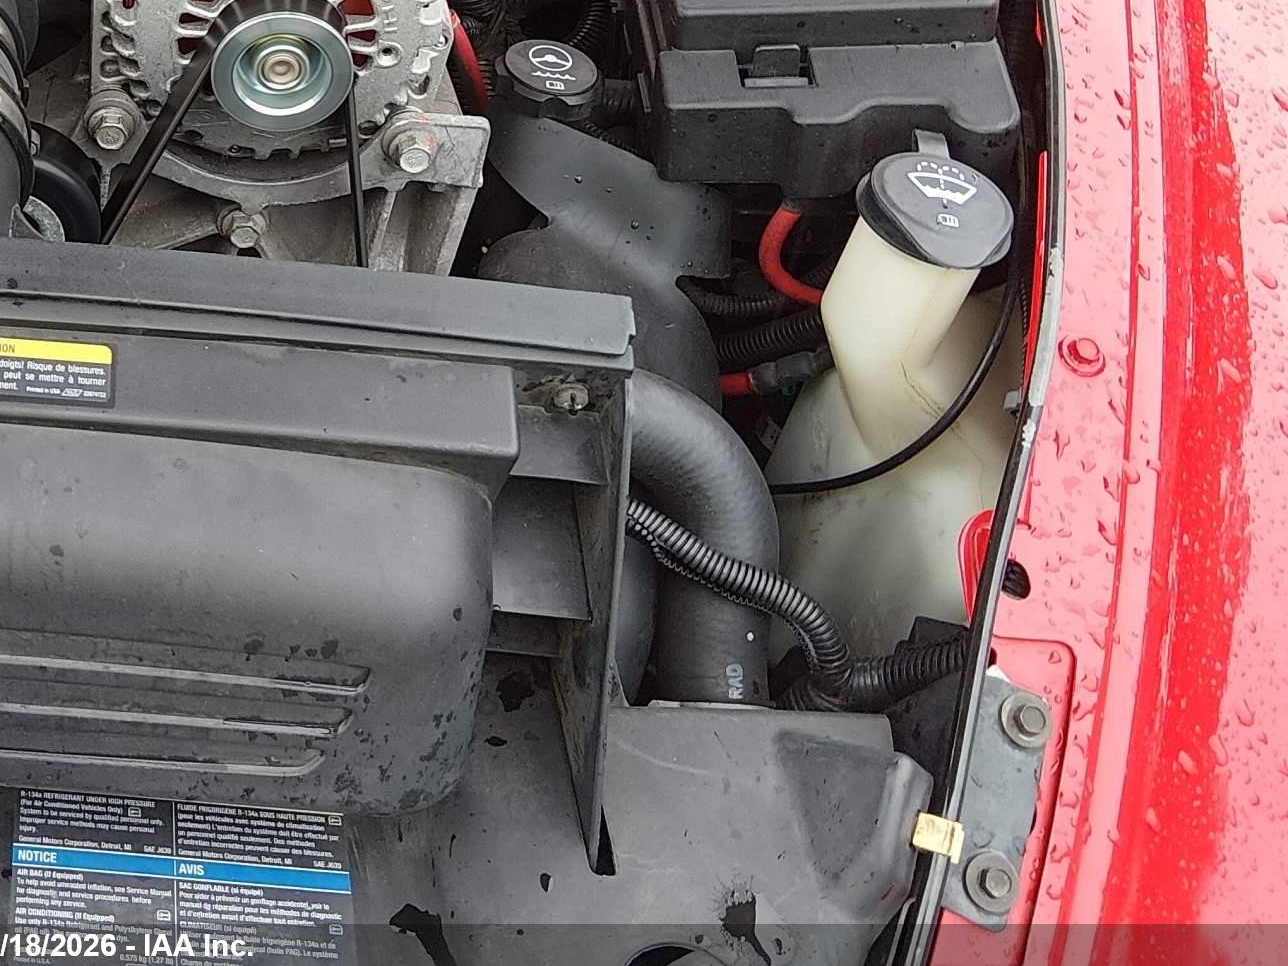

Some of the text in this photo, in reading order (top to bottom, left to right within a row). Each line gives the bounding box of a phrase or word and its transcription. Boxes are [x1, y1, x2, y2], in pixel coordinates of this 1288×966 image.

[0, 359, 24, 370] doigts!
[27, 361, 53, 372] Risque
[56, 363, 65, 372] de
[68, 364, 106, 374] blessures.
[4, 370, 21, 381] peut
[39, 373, 64, 382] mettre
[68, 375, 73, 383] à
[78, 375, 106, 385] tourner
[726, 664, 744, 700] RAD
[124, 799, 156, 807] PRESSURE
[18, 850, 57, 863] NOTICE
[179, 864, 204, 875] AVIS
[52, 872, 83, 881] Equipped)
